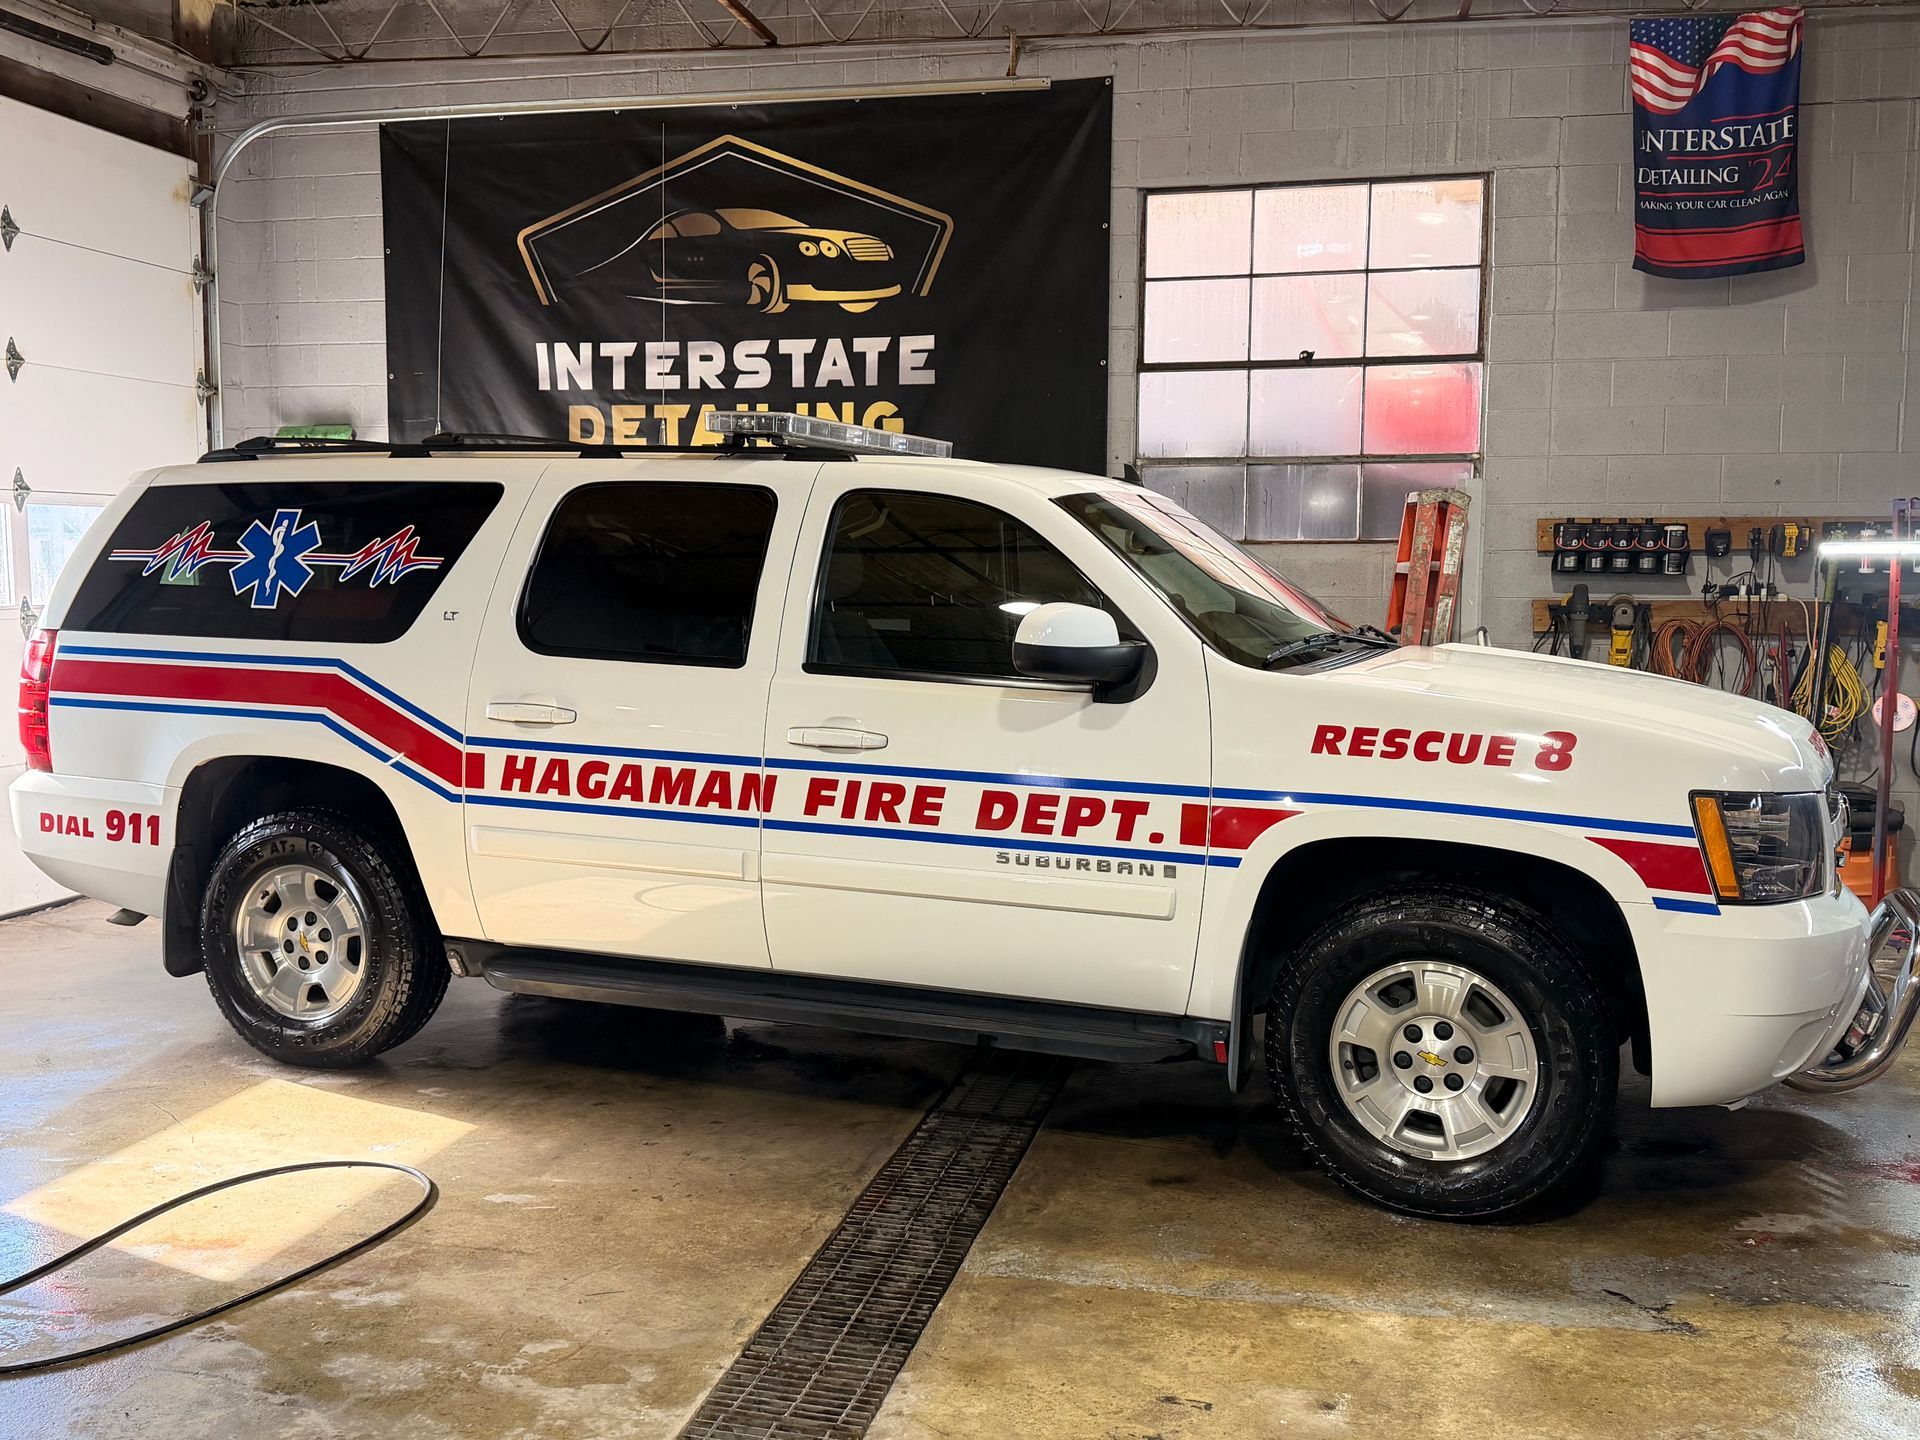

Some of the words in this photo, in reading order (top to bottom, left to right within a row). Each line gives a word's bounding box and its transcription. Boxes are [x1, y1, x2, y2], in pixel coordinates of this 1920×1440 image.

[1640, 115, 1794, 152] INTERSTATE
[1638, 166, 1740, 186] DETAILING
[1675, 200, 1704, 211] YOUR
[1707, 200, 1727, 210] CAR
[1730, 195, 1761, 209] CLEAN
[535, 335, 936, 391] INTERSTATE
[443, 610, 459, 621] LT
[1310, 724, 1518, 768] RESCUE
[1534, 731, 1578, 772] 8
[500, 754, 778, 813] HAGAMAN
[803, 777, 947, 826] FIRE
[975, 789, 1165, 845] DEPT.
[40, 811, 95, 839] DIAL
[105, 809, 161, 847] 911
[996, 851, 1155, 877] SUBURBAN
